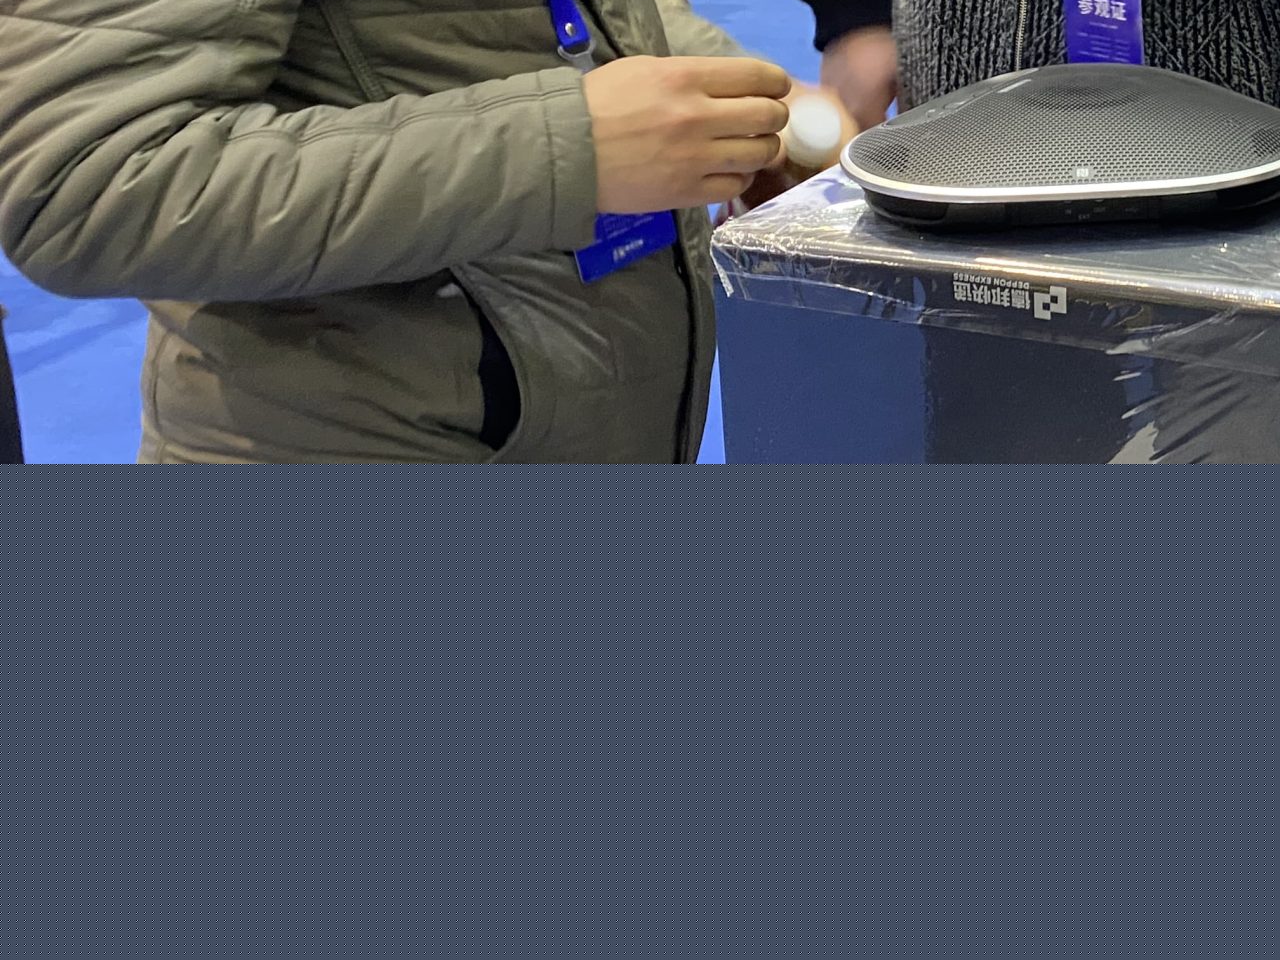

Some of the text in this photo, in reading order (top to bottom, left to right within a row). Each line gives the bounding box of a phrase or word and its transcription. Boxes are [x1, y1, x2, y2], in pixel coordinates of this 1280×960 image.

[953, 271, 1030, 289] DEPPON EXPRESS
[953, 281, 1031, 310] 德邦快递
